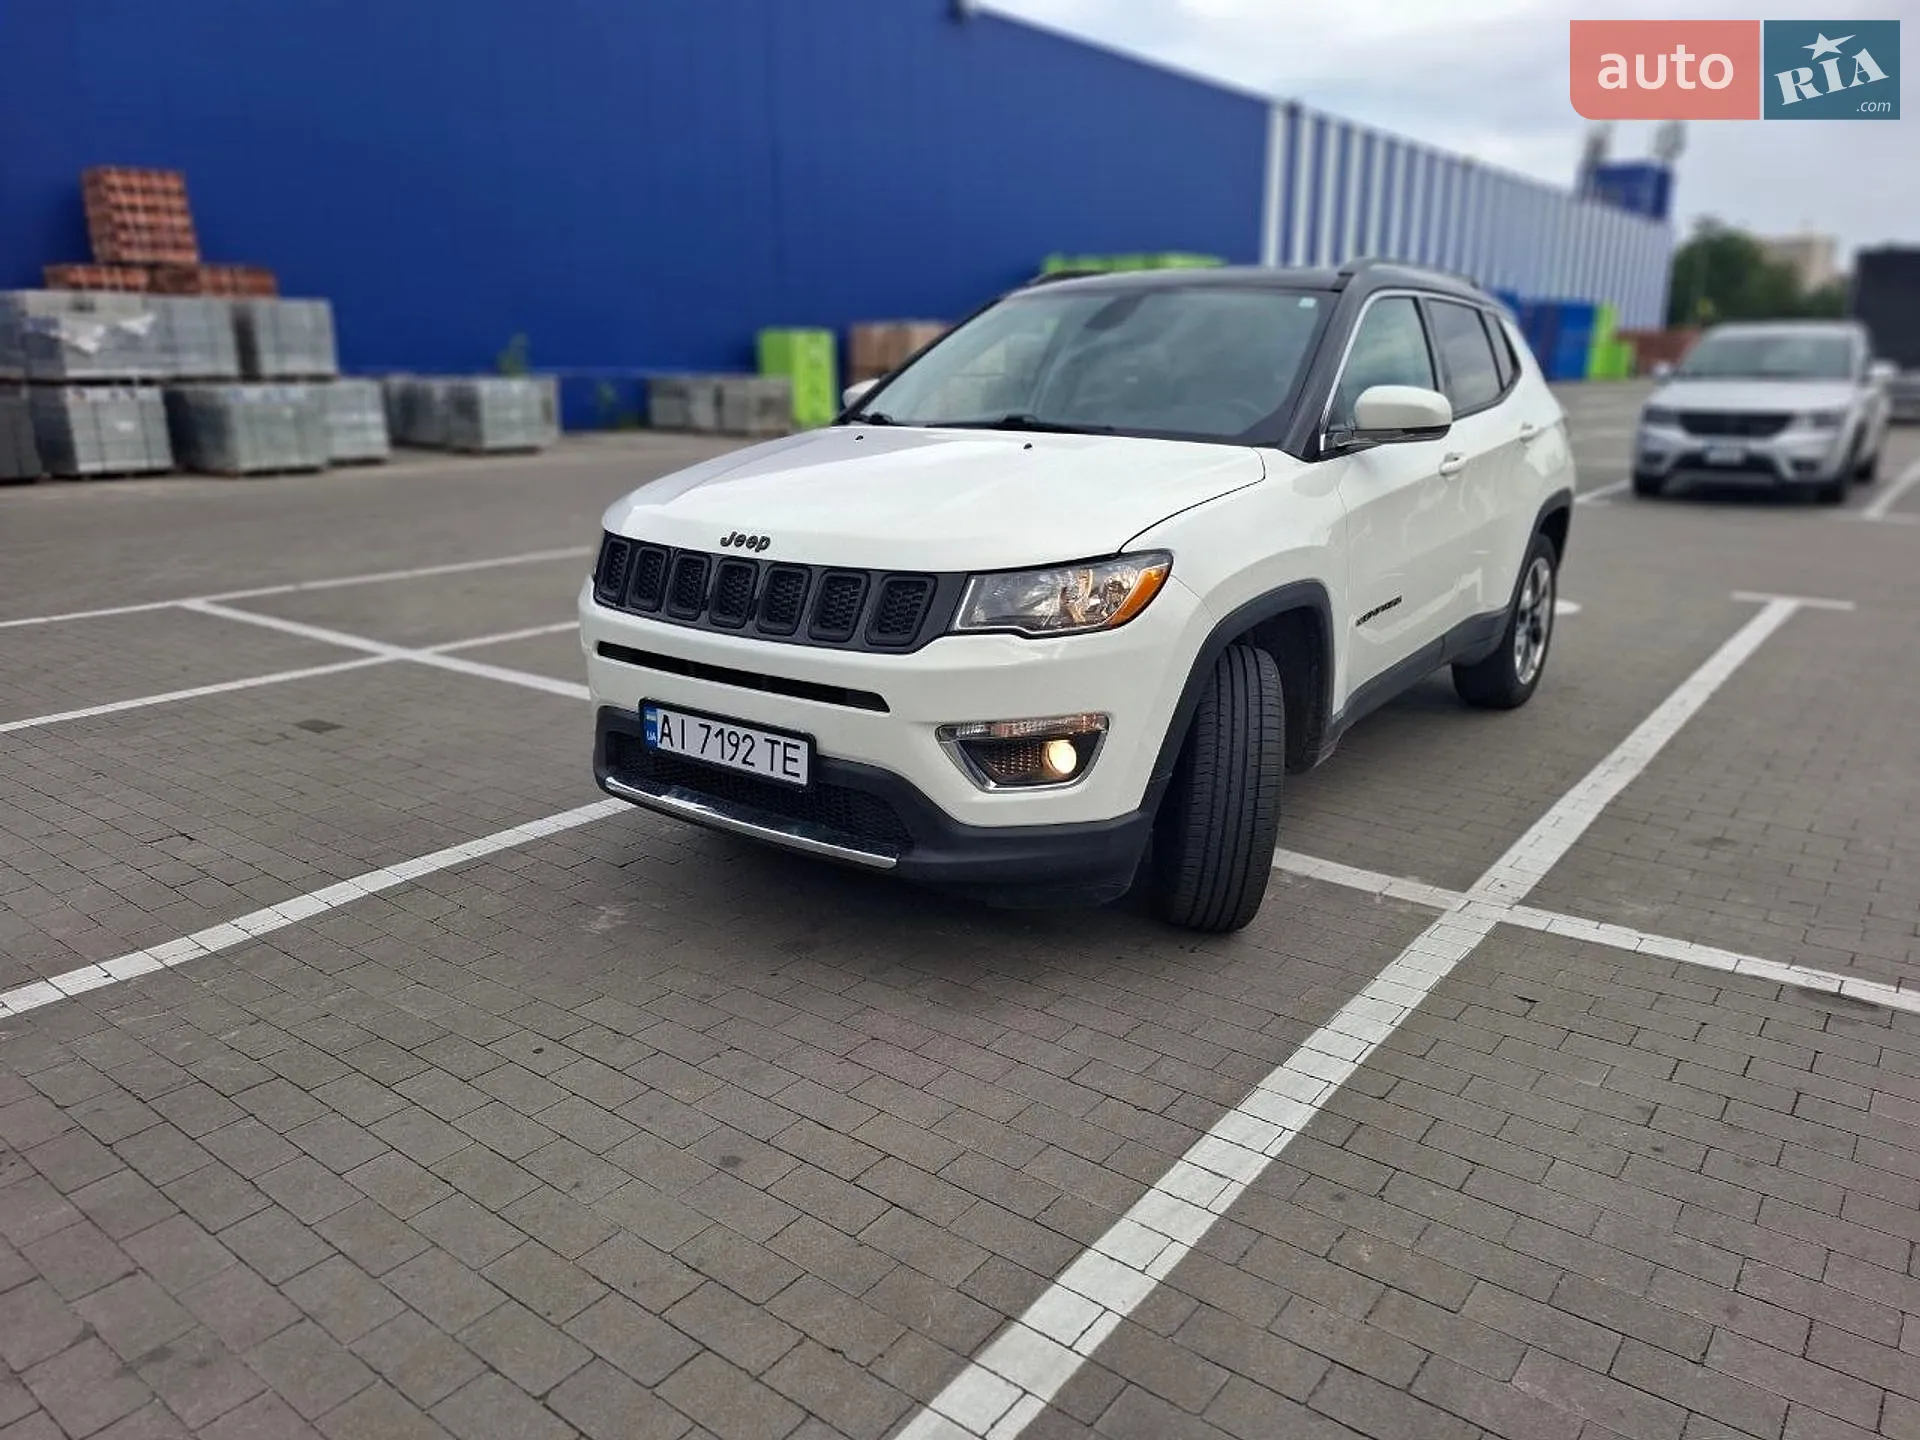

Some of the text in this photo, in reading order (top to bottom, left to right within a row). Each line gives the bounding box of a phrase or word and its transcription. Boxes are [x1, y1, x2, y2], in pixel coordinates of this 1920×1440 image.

[720, 531, 770, 553] Jeep
[659, 714, 801, 777] AI 7192 TE
